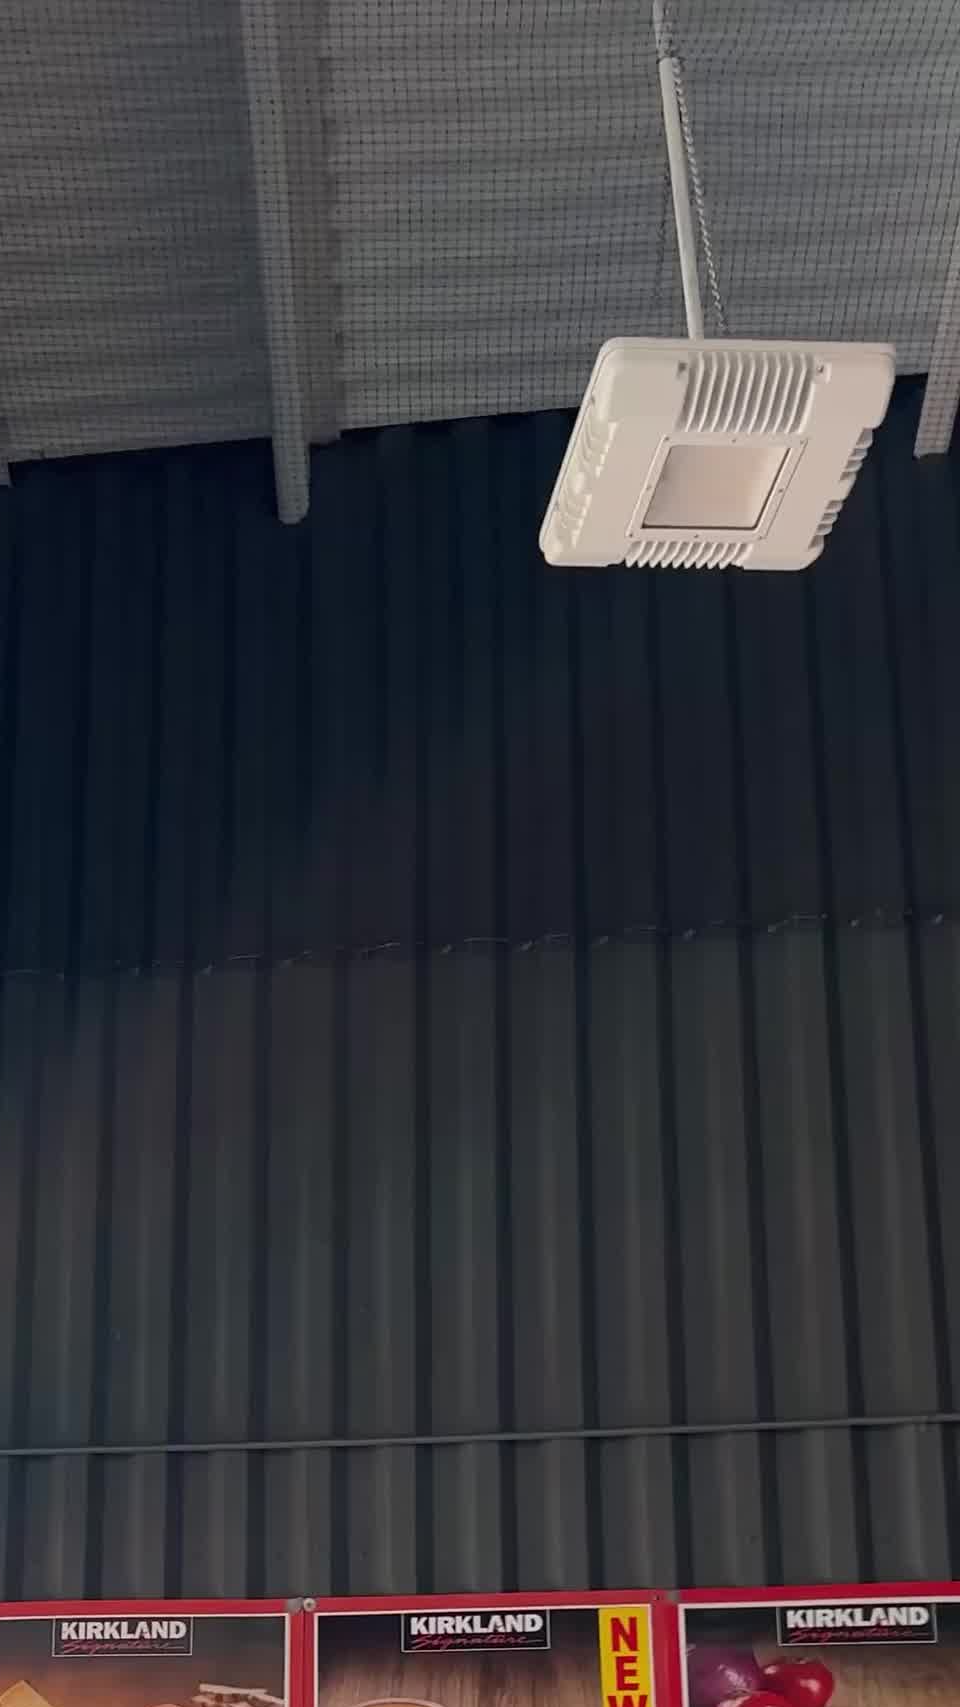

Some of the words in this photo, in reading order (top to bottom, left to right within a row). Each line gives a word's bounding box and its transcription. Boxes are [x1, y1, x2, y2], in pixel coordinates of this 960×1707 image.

[410, 1614, 543, 1635] KIRKLAND
[786, 1606, 929, 1628] KIRKLAND
[61, 1621, 187, 1640] KIRKLAND
